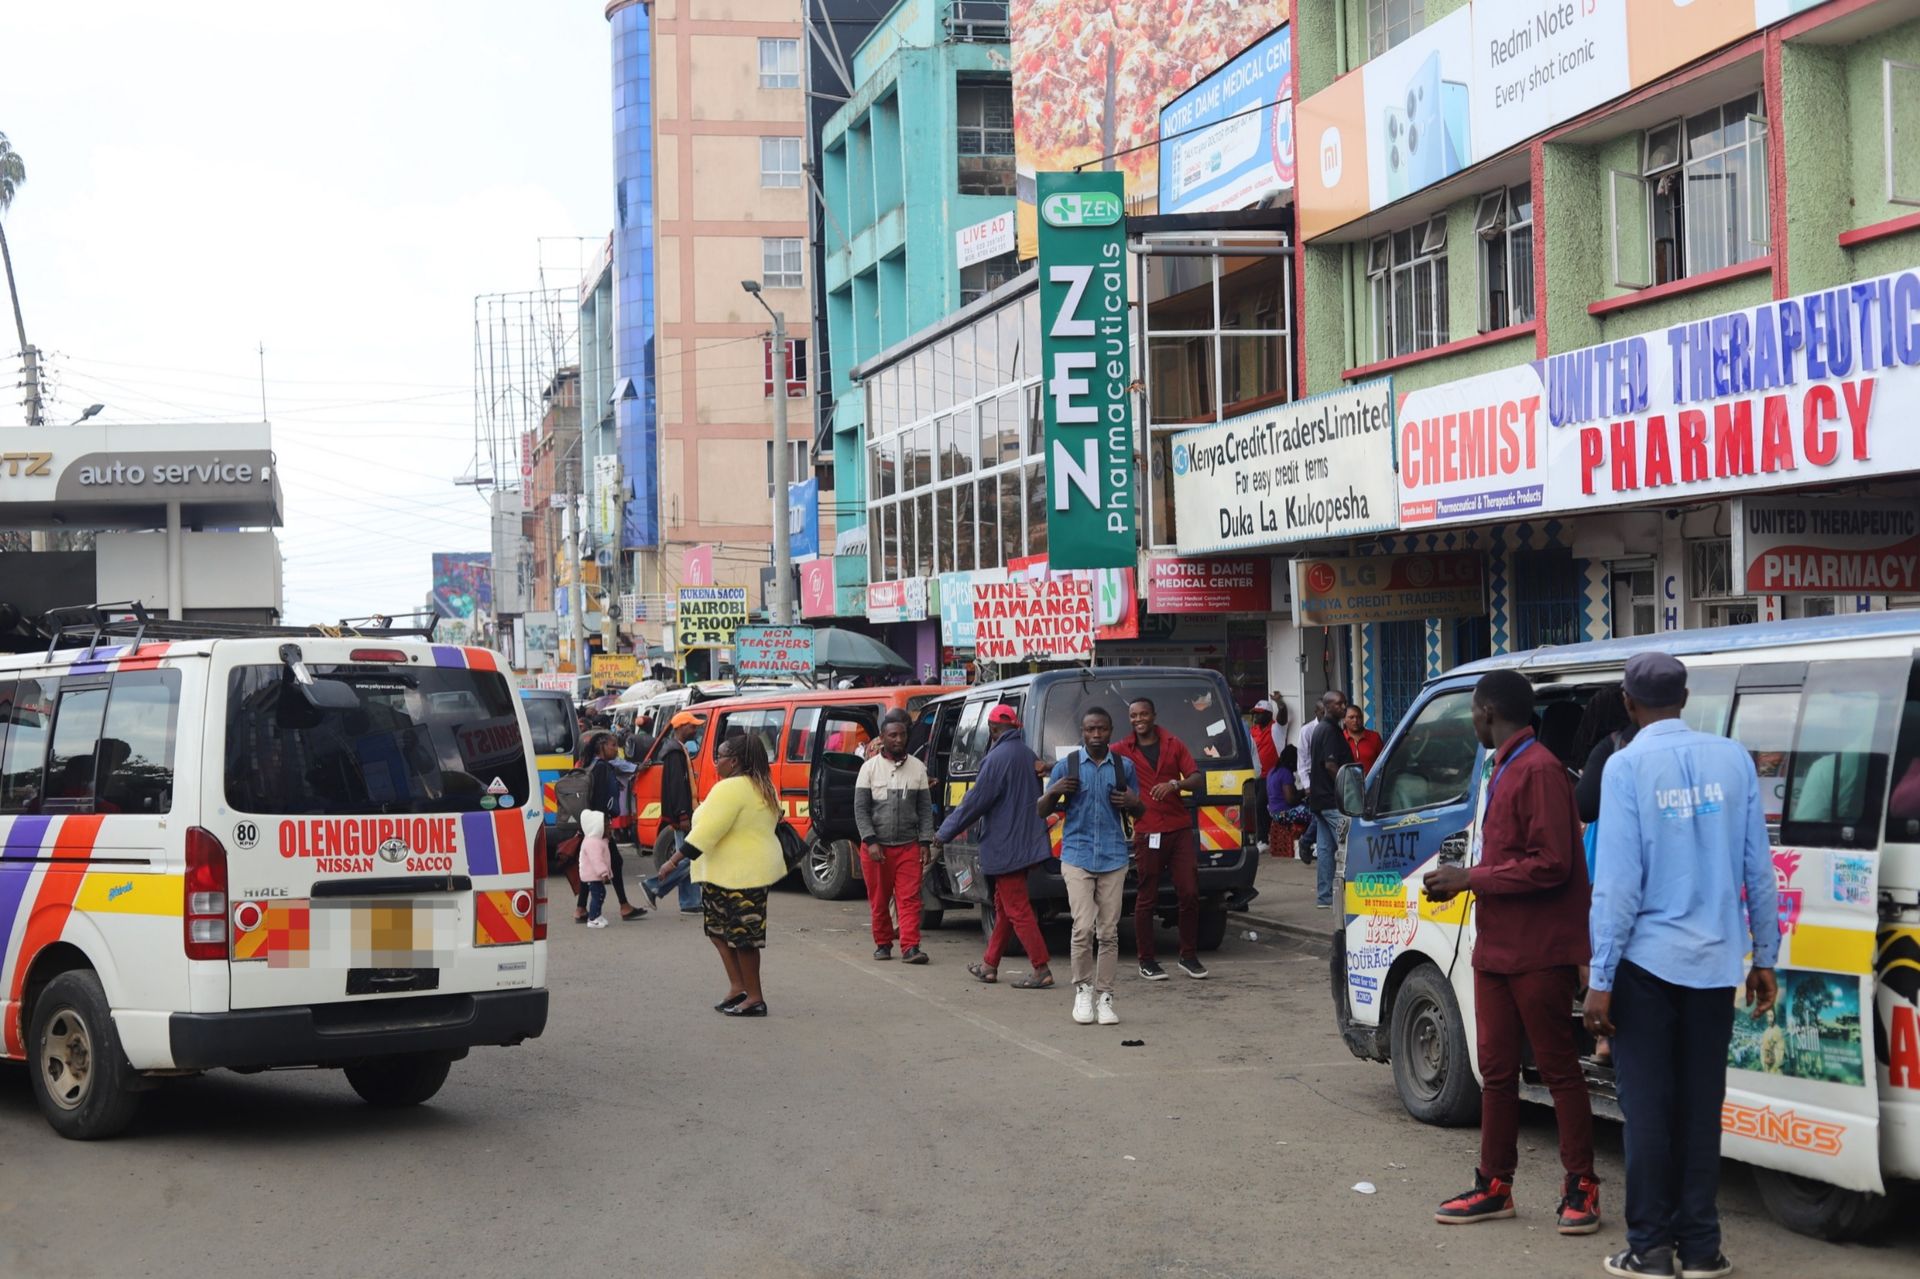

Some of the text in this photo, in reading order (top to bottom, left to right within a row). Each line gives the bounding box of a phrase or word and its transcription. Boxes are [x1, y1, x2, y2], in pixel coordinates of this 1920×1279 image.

[1490, 19, 1532, 68] Redmi
[1536, 3, 1574, 42] Note
[1495, 38, 1595, 108] Every shot iconic
[1164, 104, 1193, 137] NOTRE
[1195, 84, 1220, 117] DAME
[1222, 59, 1264, 102] MEDICAL
[1081, 200, 1120, 217] ZEN
[963, 223, 987, 245] LIVE
[991, 217, 1006, 235] AD
[1548, 272, 1920, 428] UNITED THERAPEUTIC
[1048, 265, 1101, 510] ZEN
[1102, 242, 1128, 534] Pharmaceuticals
[1401, 395, 1540, 489] CHEMIST
[1580, 378, 1877, 496] PHARMACY
[0, 452, 52, 477] TZ
[79, 457, 252, 486] auto service
[1235, 456, 1329, 496] For easy credit terms
[1219, 485, 1370, 539] Duka La Kukopesha
[1438, 490, 1541, 515] Pharmaceutical & Therapeutic Products
[1750, 509, 1914, 535] UNITED THERAPEUTIC
[1156, 563, 1254, 576] NOTRE DAME
[1340, 564, 1377, 588] LG
[1438, 556, 1476, 582] LG
[1764, 554, 1918, 588] PHARMACY
[680, 588, 744, 599] KUKENA SACCO
[976, 581, 1091, 600] VINEYARD
[1156, 577, 1254, 589] MEDICAL CENTER
[680, 601, 745, 615] NAIROBI
[974, 598, 1091, 619] MAWANGA
[1302, 590, 1482, 611] KENYA CREDIT TRADERS LTD
[680, 617, 746, 630] T-ROOM
[763, 630, 792, 638] MCN
[975, 621, 1004, 640] ALL
[1015, 617, 1091, 637] NATION
[740, 639, 810, 648] TEACHERS
[976, 635, 1093, 657] KWA KIHIKA
[740, 660, 811, 671] MAWANGA
[1704, 783, 1724, 802] 44
[237, 824, 256, 841] 80
[1366, 831, 1420, 864] WAIT
[316, 857, 453, 872] NISSAN SACCO
[1347, 945, 1395, 971] COURAGE
[1787, 1008, 1820, 1058] Psalm
